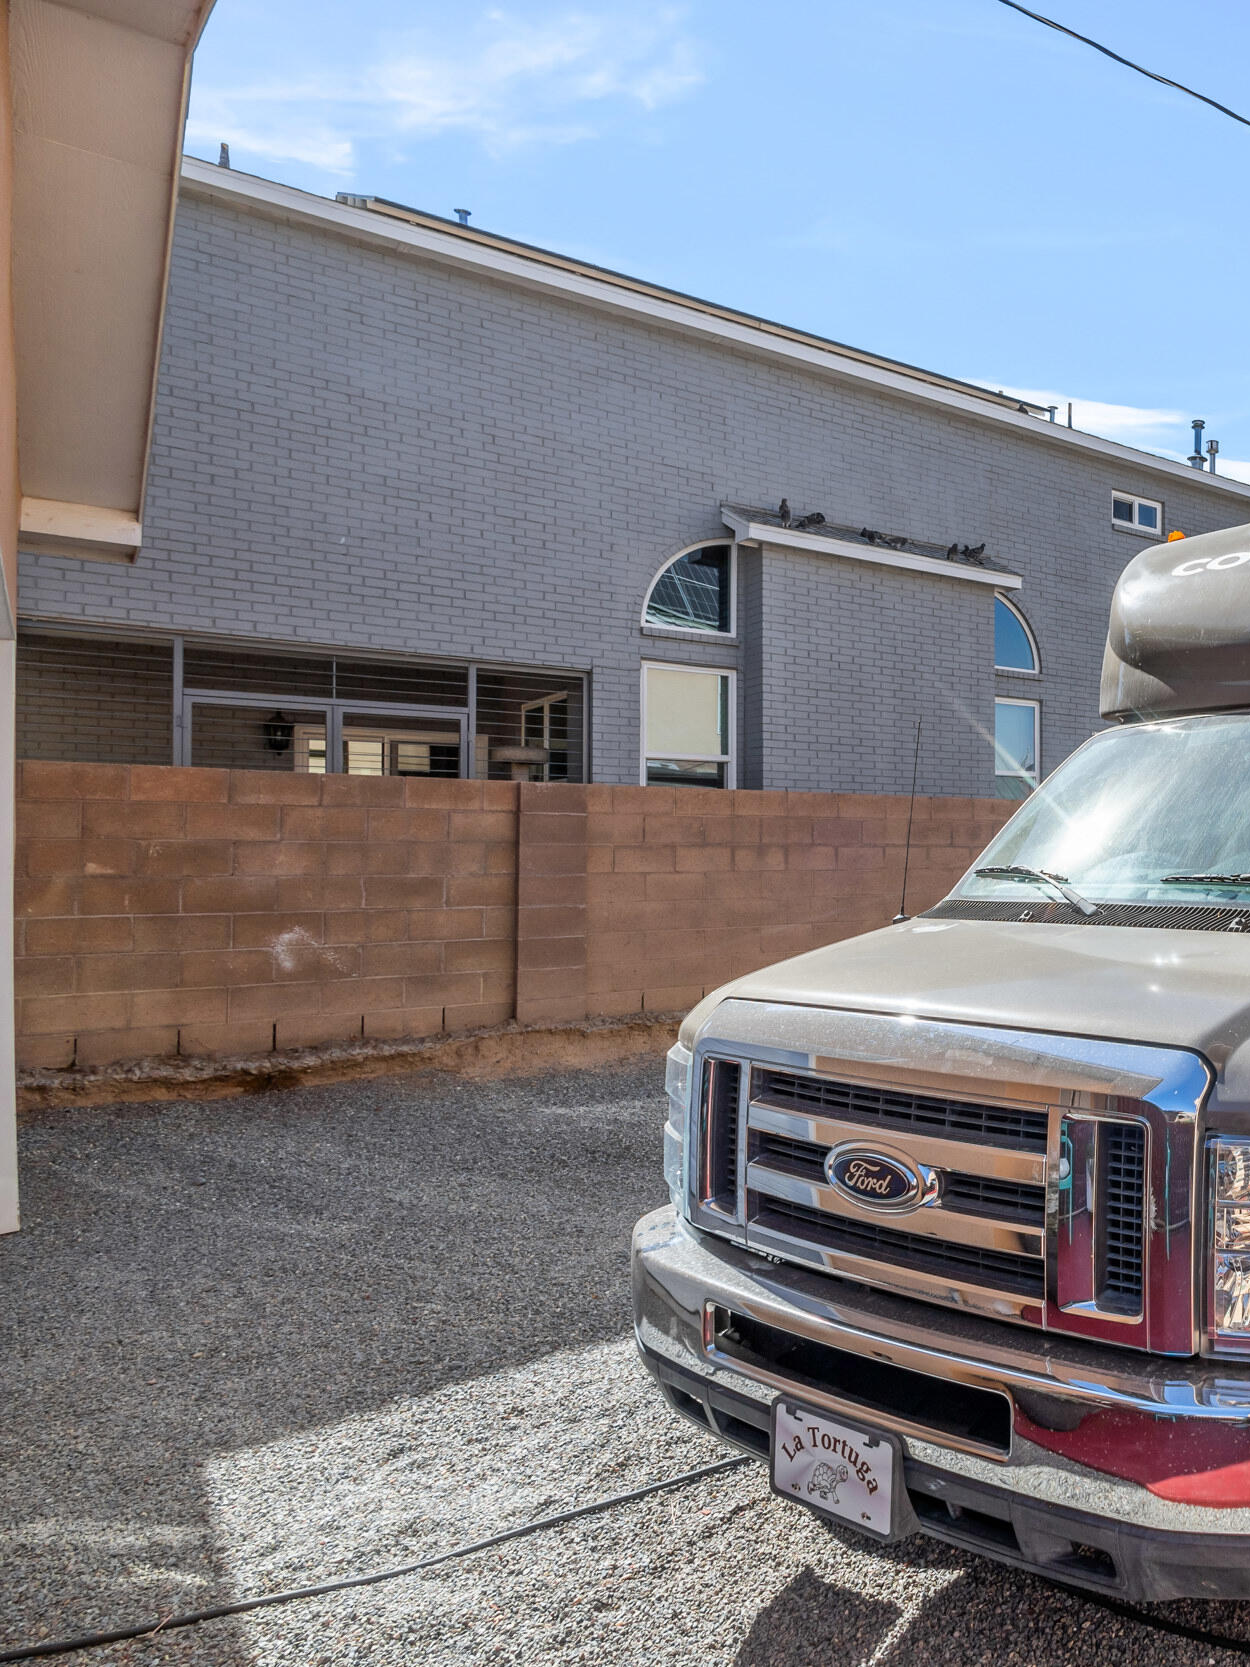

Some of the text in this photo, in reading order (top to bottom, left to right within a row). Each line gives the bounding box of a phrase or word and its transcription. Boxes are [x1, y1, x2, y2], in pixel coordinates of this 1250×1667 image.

[844, 1160, 892, 1195] Ford
[781, 1426, 879, 1496] La Tortuga
